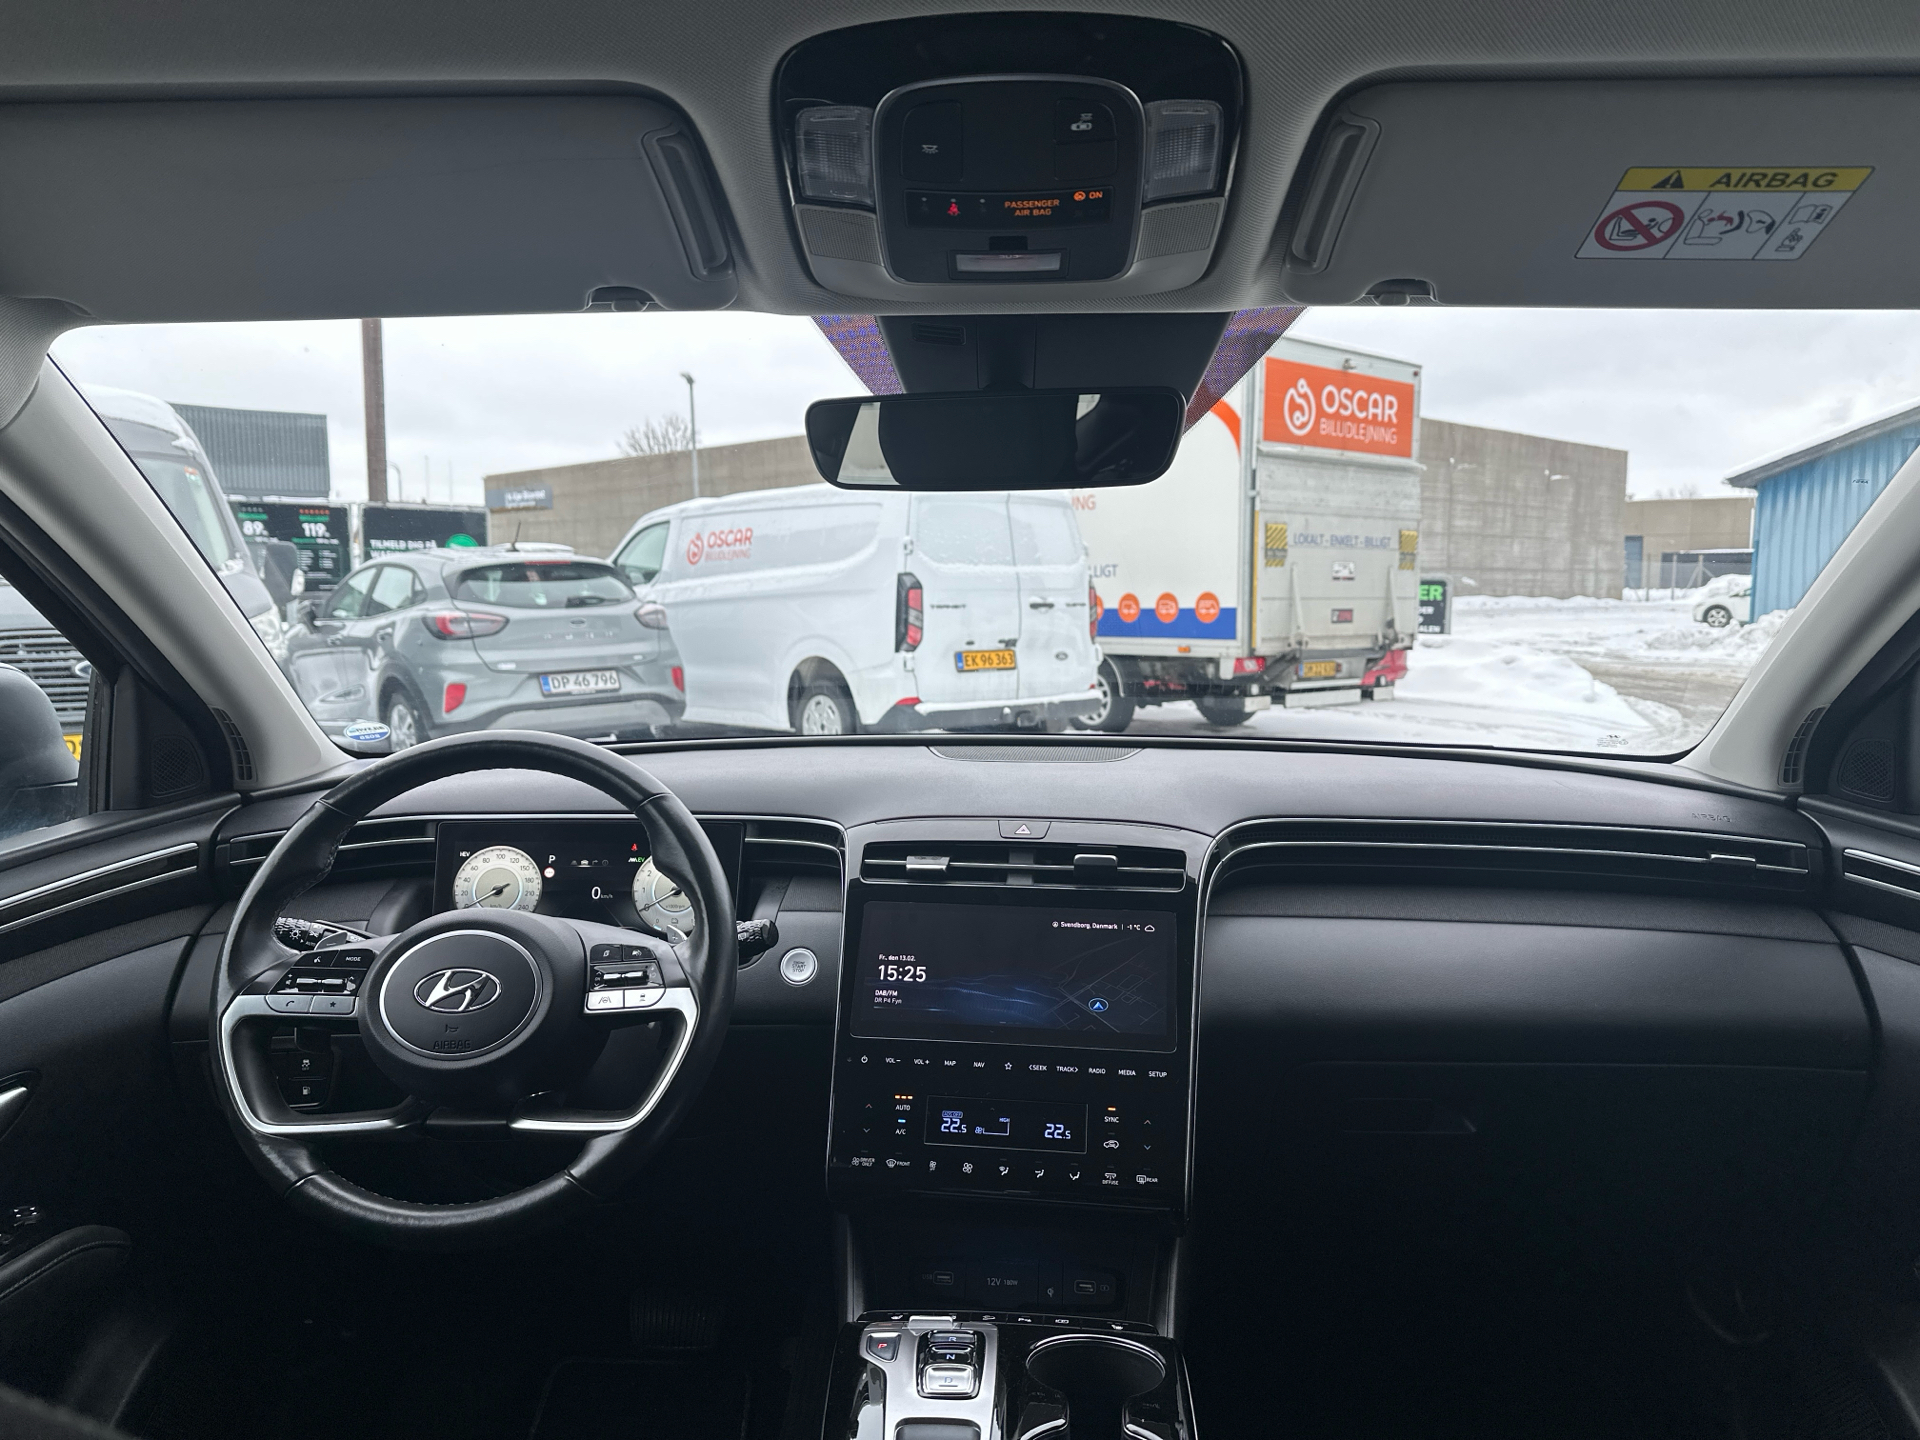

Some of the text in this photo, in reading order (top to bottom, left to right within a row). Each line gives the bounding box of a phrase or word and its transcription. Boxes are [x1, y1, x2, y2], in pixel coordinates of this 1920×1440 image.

[1709, 172, 1839, 188] AIRBAG
[1088, 191, 1103, 199] ON
[1004, 199, 1060, 208] PASSENGER
[1032, 208, 1052, 216] BAG
[1321, 384, 1398, 424] OSCAR
[1320, 417, 1397, 444] BILUDLEJNING
[370, 539, 406, 550] TILMELD
[707, 526, 753, 549] OSCAR
[1293, 533, 1391, 548] LOKALT ENKELT BILLIGT
[964, 652, 1014, 667] EK 96 363
[551, 672, 617, 689] DP 46 796
[548, 854, 556, 864] P
[591, 886, 601, 900] 0
[1092, 922, 1118, 930] Danmark
[878, 964, 927, 983] 15:25
[874, 989, 898, 997] DAB/FM
[433, 1040, 471, 1050] AIRBAG
[941, 1118, 967, 1133] 22.5
[1044, 1123, 1071, 1139] 22.5
[986, 1277, 1001, 1286] 12V
[944, 1376, 953, 1384] D
